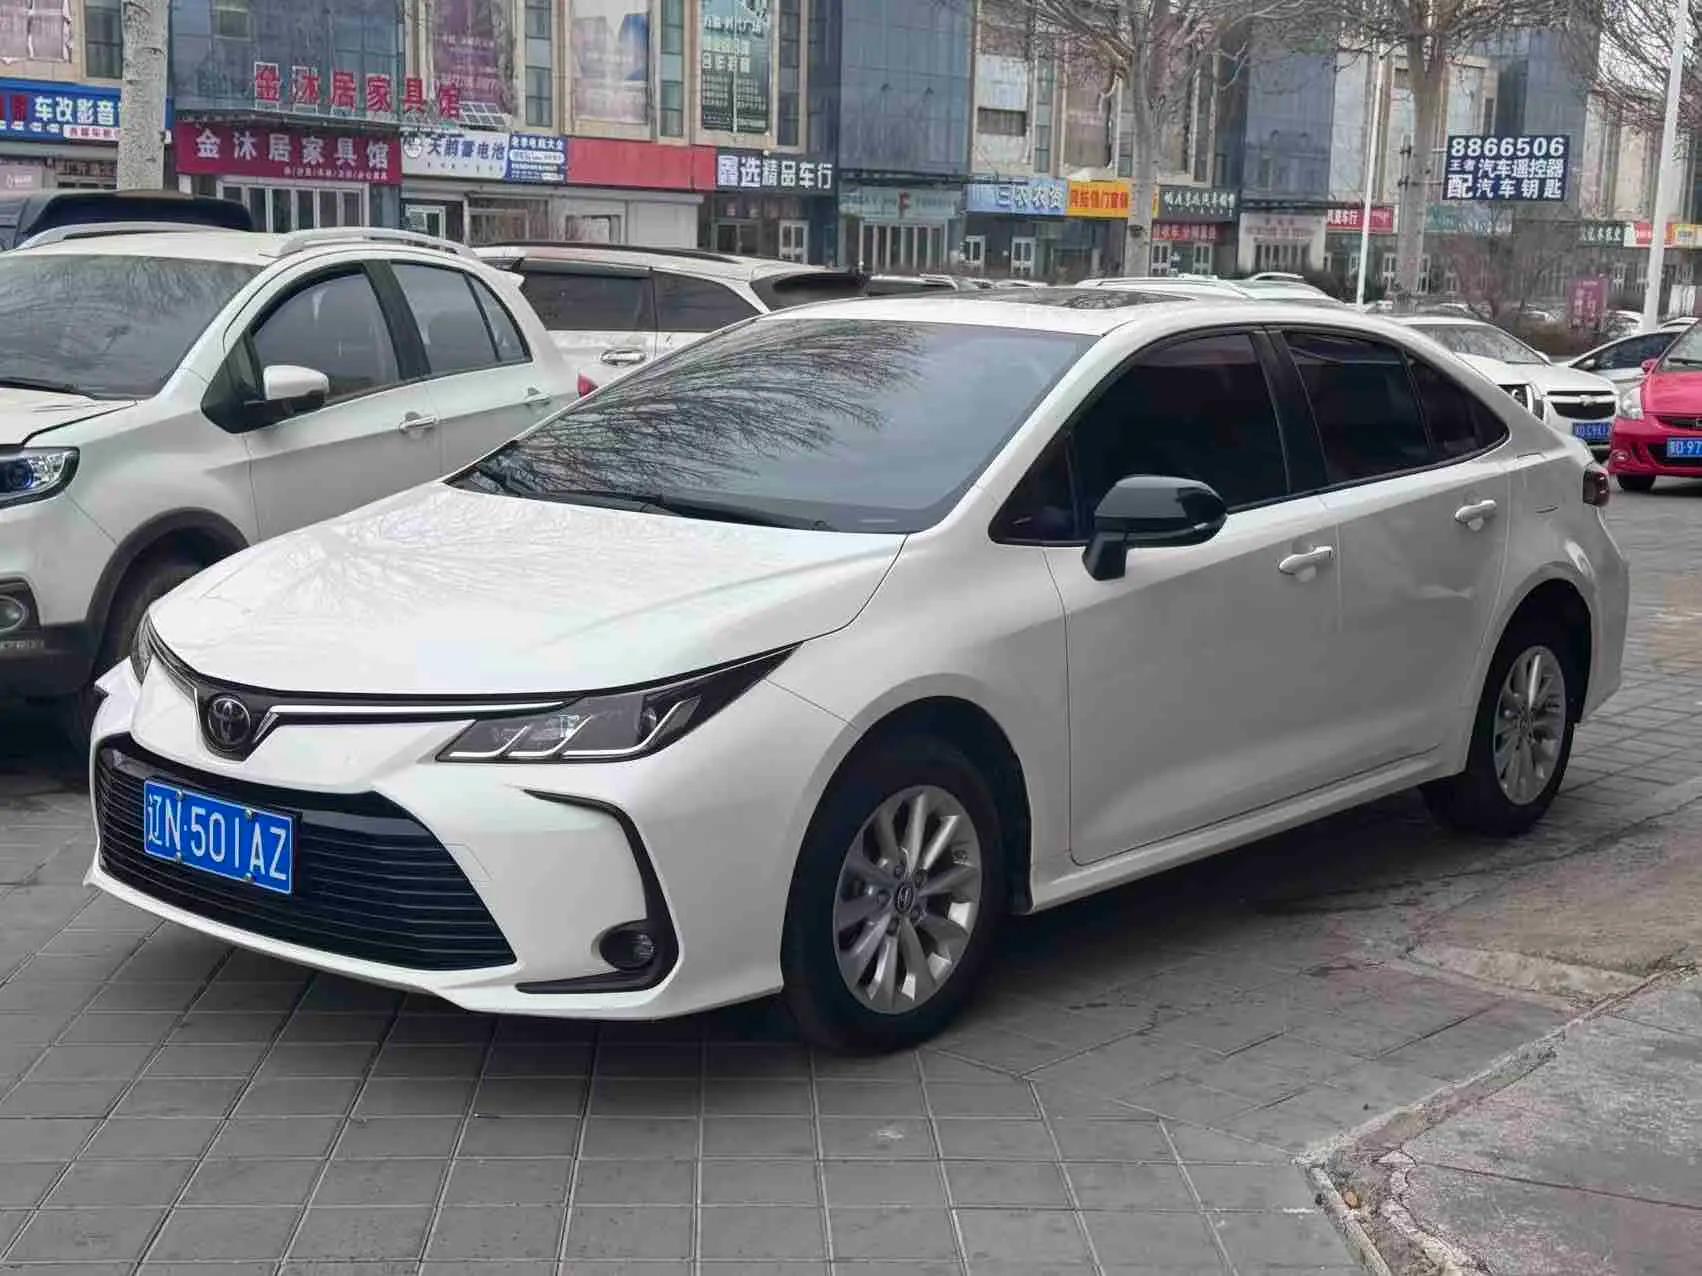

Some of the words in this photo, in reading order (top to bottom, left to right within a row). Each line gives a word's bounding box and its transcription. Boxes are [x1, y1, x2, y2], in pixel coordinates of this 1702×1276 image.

[34, 96, 121, 126] 车改影音
[195, 128, 390, 169] 金沐居家具馆
[1450, 136, 1565, 157] 8866506
[1478, 157, 1564, 178] 汽车遥控器
[1447, 174, 1473, 198] 配
[1476, 178, 1562, 198] 汽车钥匙
